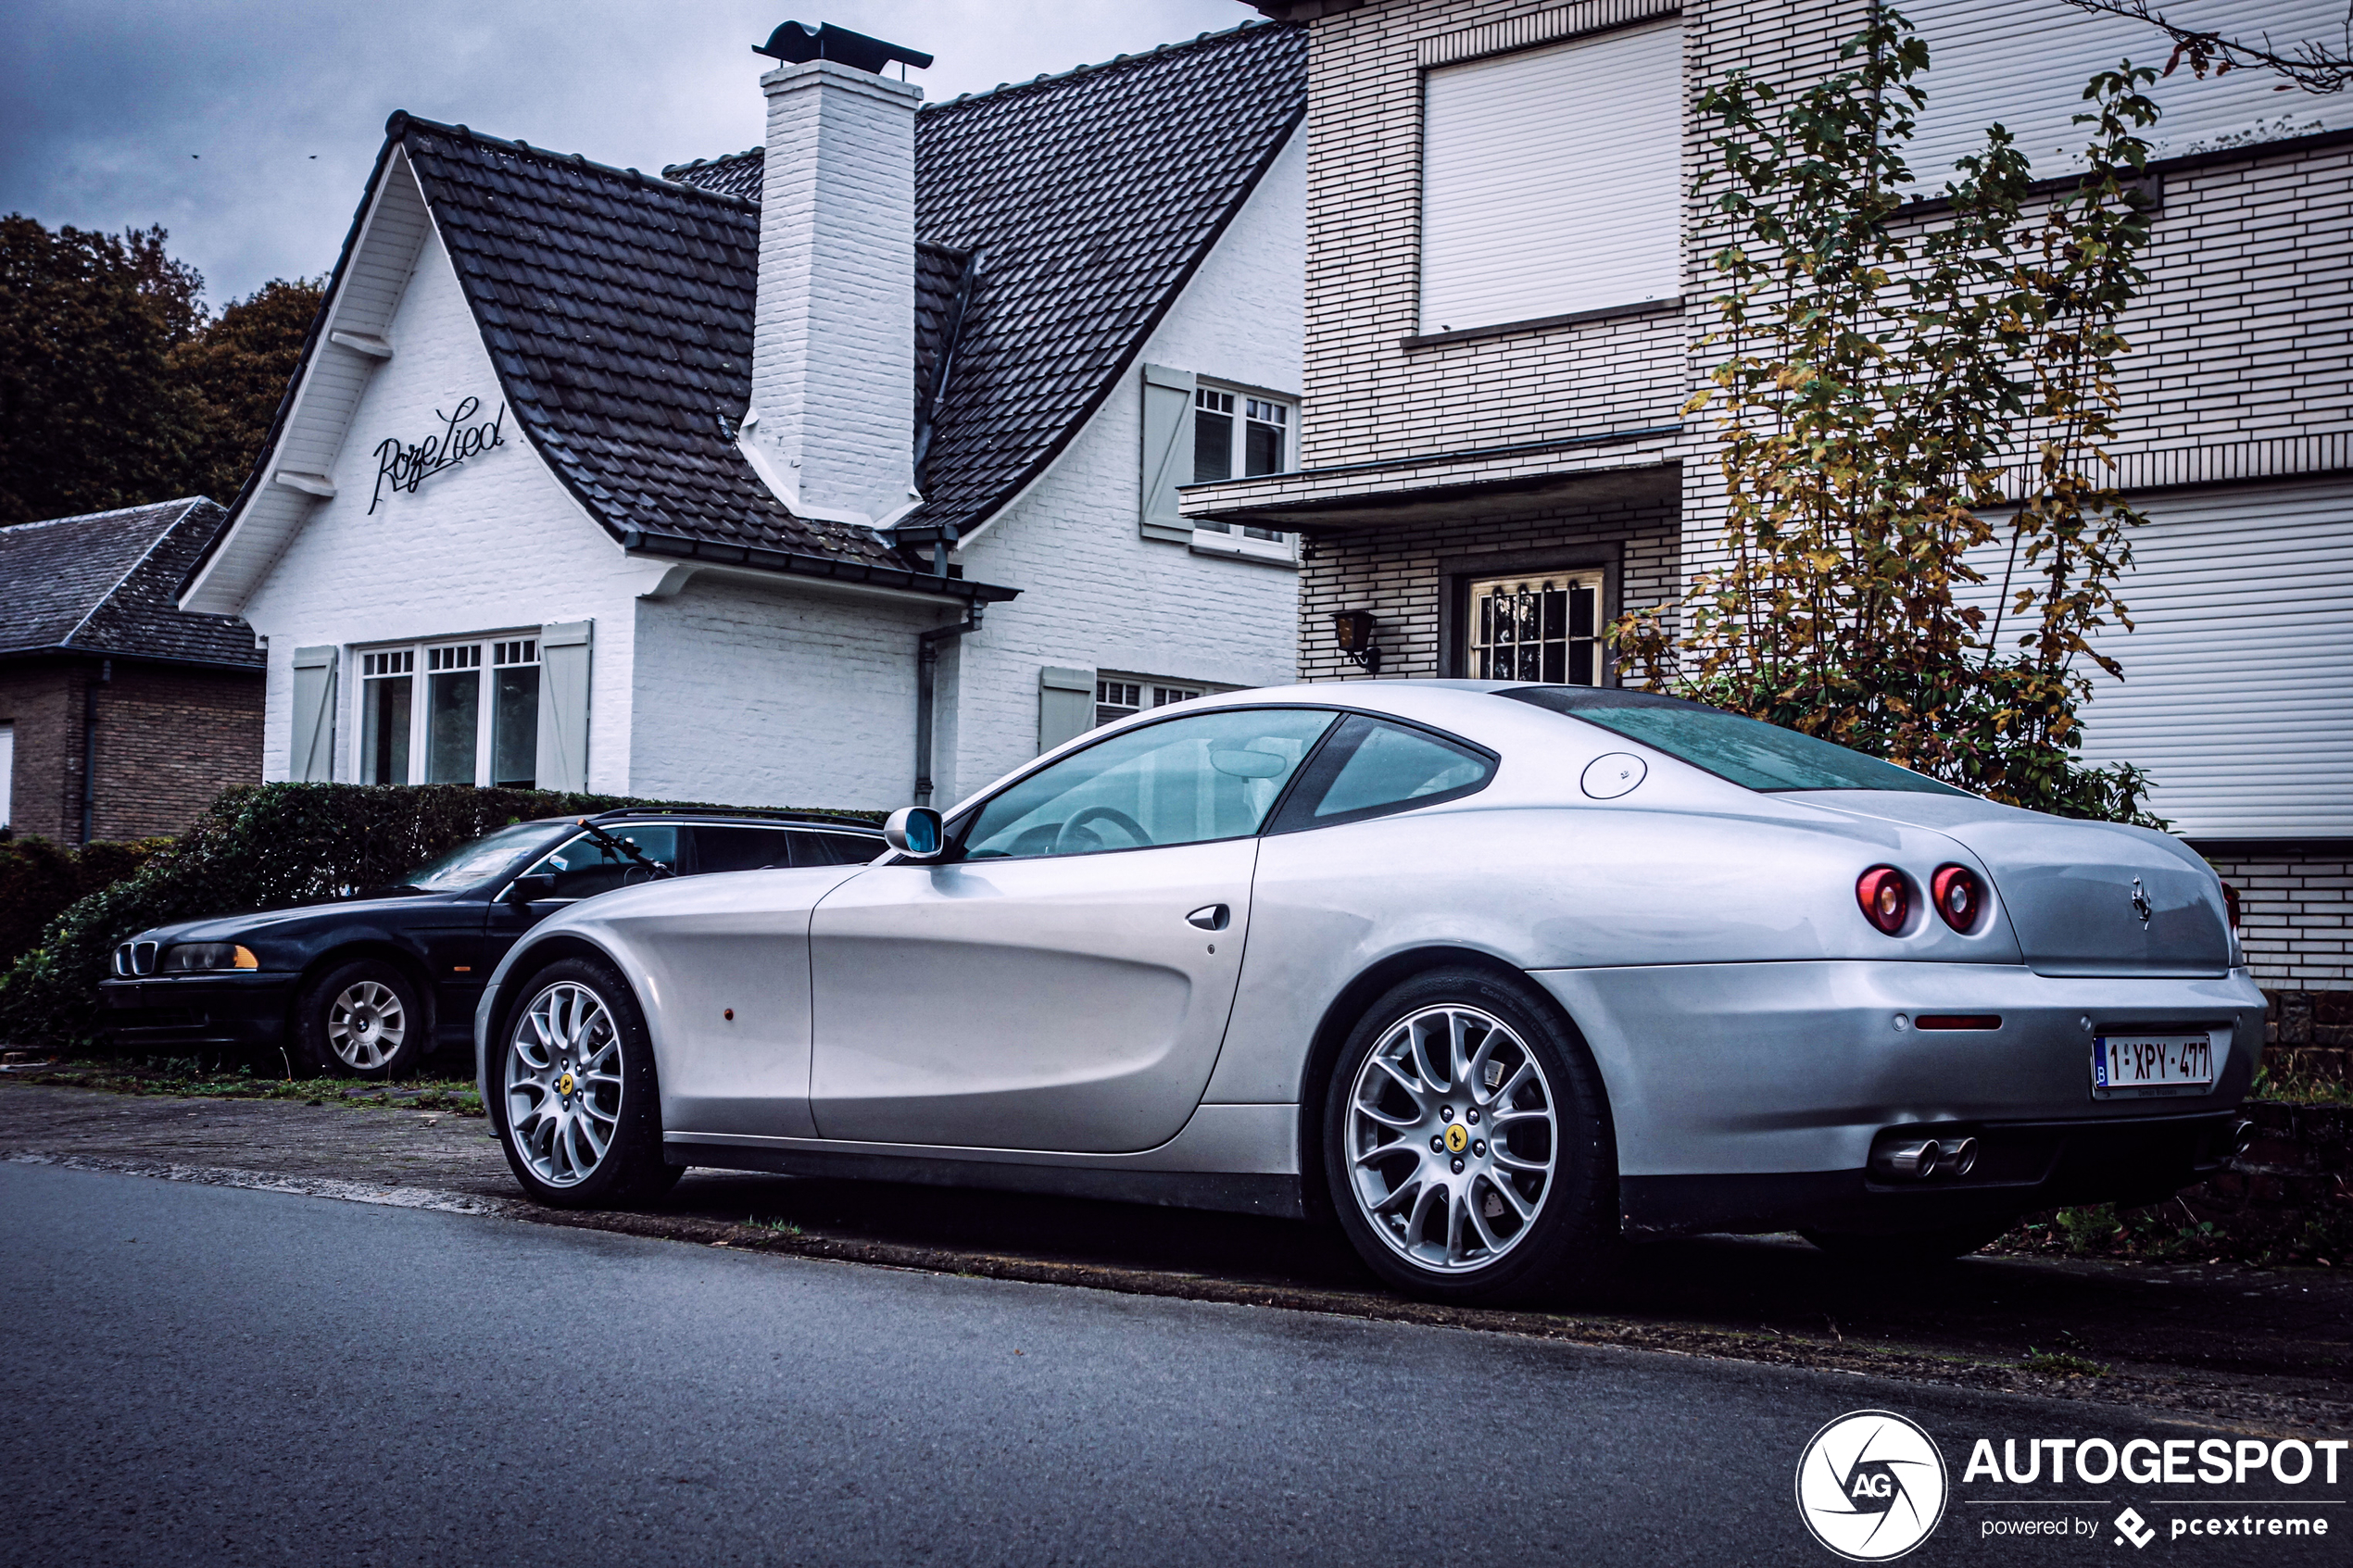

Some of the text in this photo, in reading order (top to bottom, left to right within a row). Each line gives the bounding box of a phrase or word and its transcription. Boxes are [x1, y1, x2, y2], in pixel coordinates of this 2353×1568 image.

[368, 396, 505, 515] Roze Lied
[2097, 1066, 2106, 1083] B
